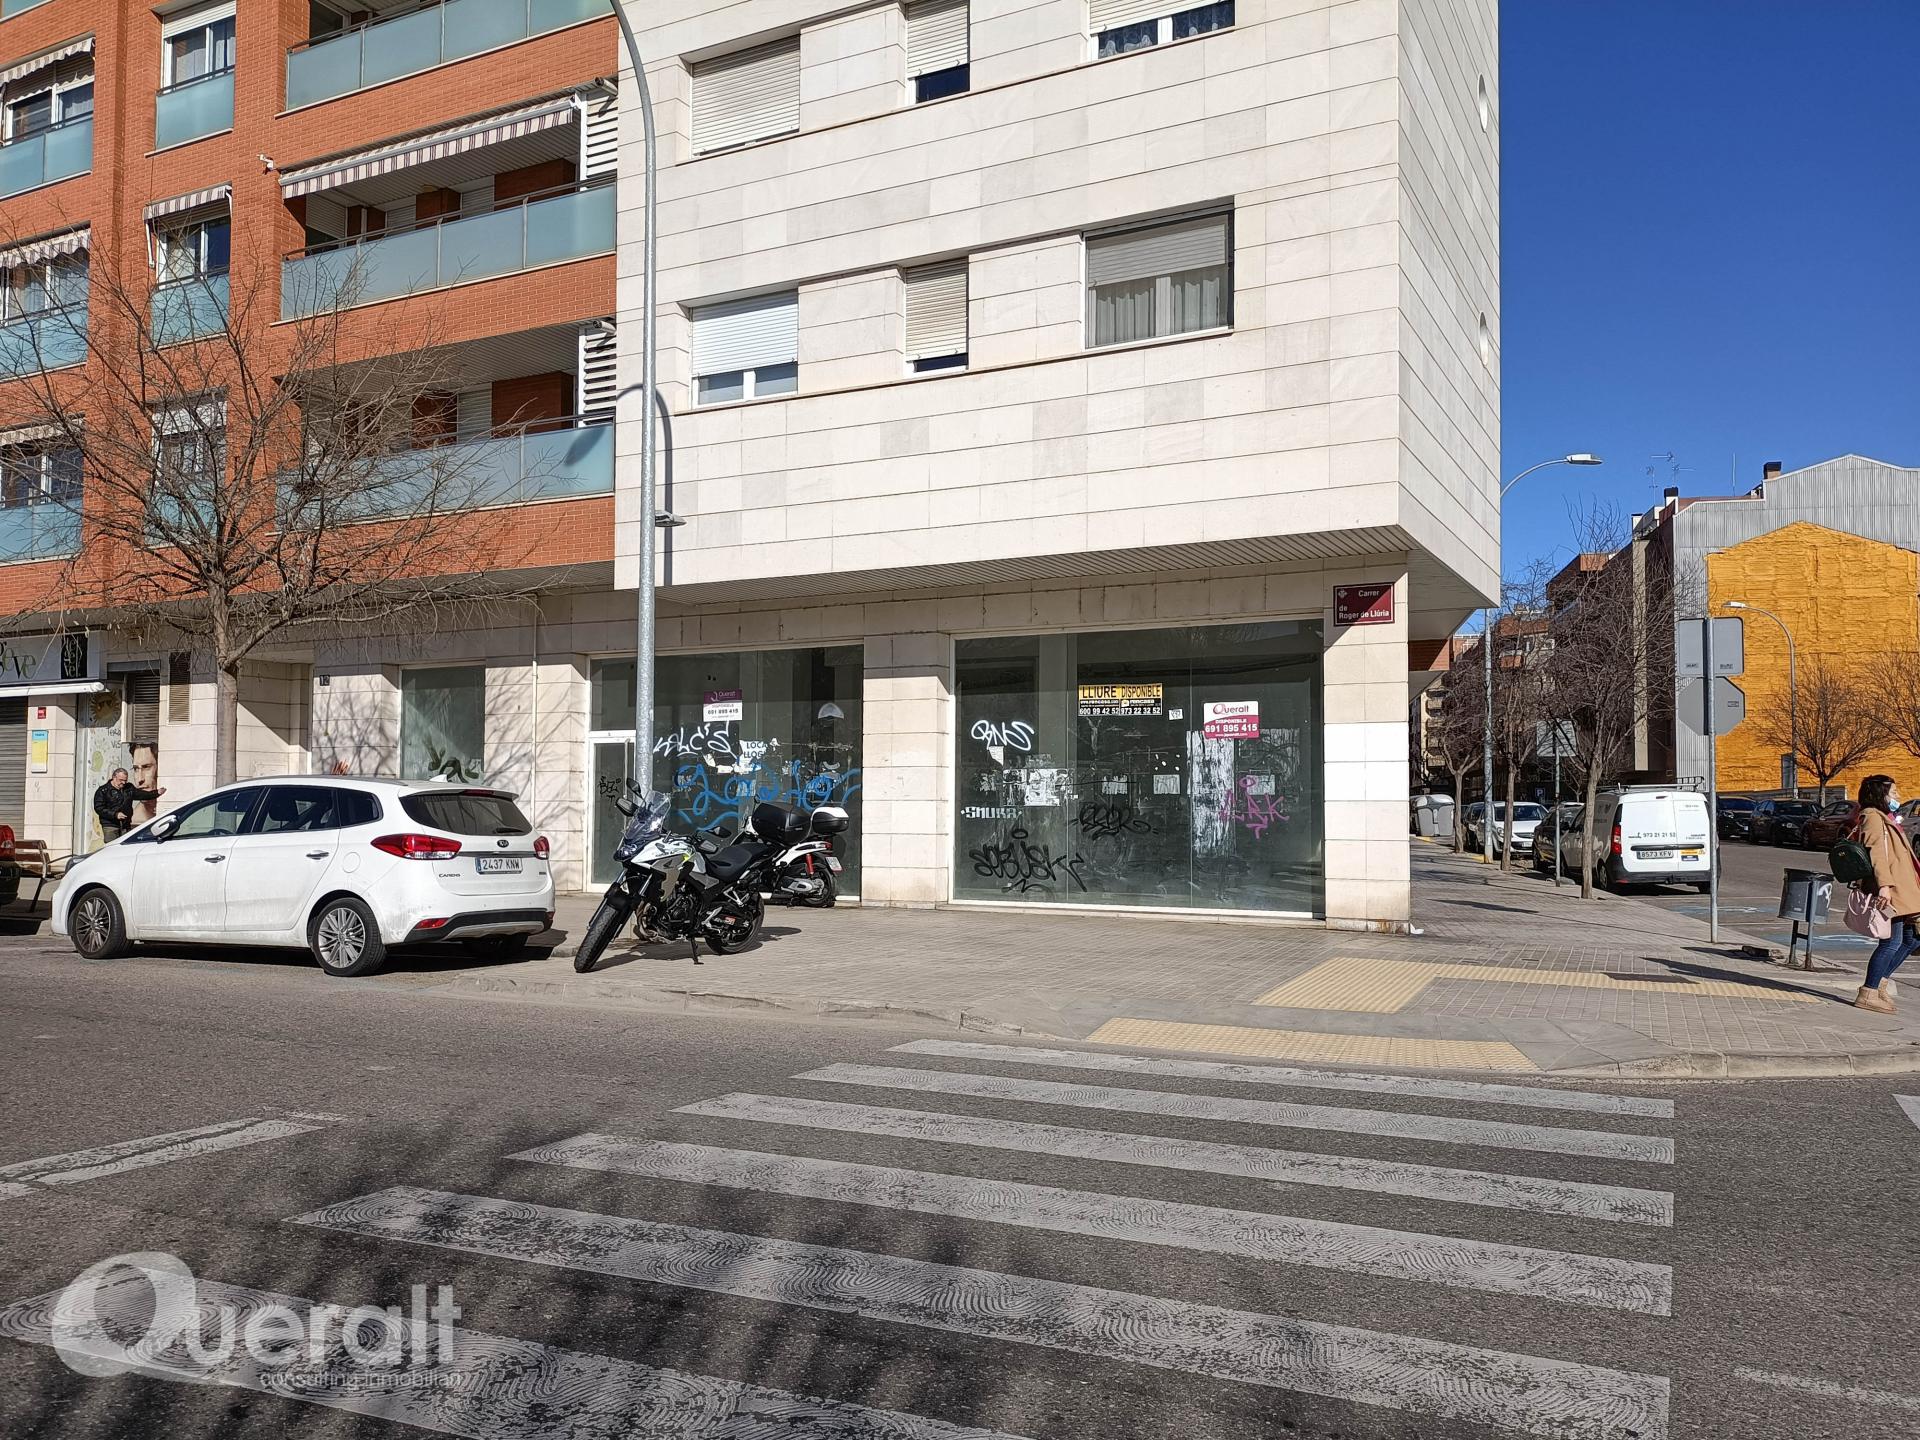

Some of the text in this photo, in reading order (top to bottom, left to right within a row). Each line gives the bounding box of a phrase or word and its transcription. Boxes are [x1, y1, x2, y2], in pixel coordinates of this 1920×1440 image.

[1338, 612, 1360, 620] Roger
[1370, 609, 1390, 618] Llúria
[320, 675, 330, 685] 12
[1082, 685, 1161, 698] LLIURE DISPONIBLE
[1101, 707, 1110, 715] 42
[1213, 703, 1249, 714] Queralt
[1223, 724, 1239, 732] 895
[1241, 723, 1258, 732] 415
[1641, 850, 1658, 858] 8573
[483, 859, 520, 870] 2437 KNW
